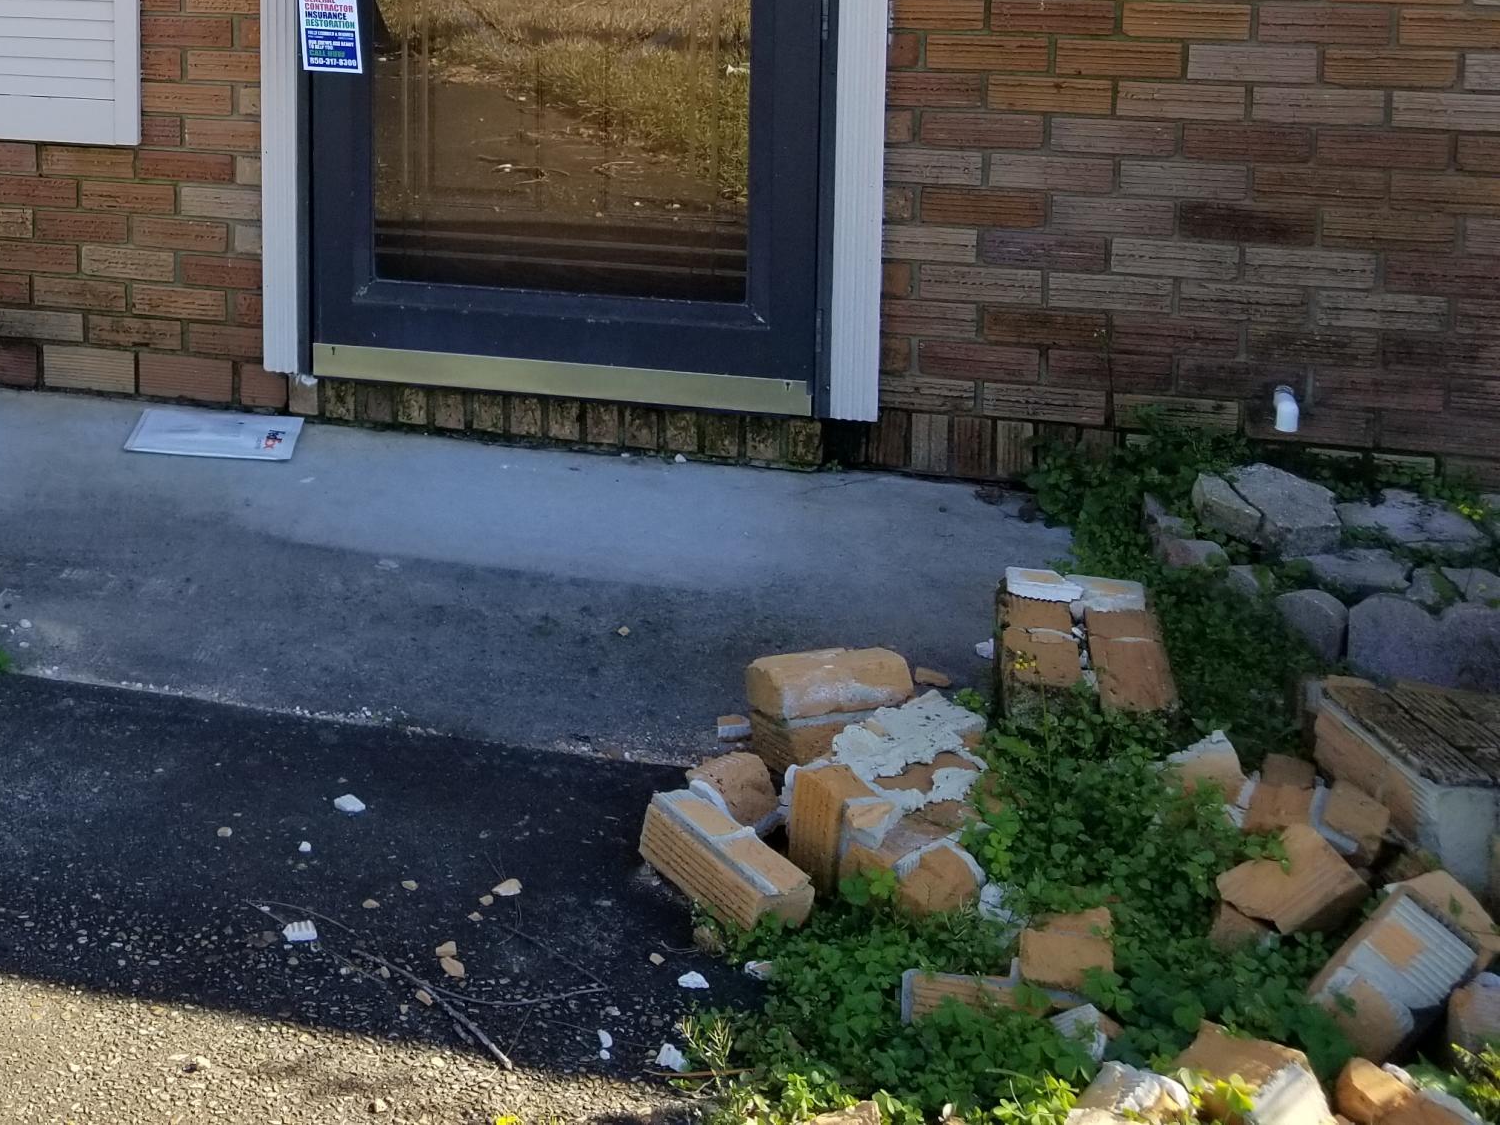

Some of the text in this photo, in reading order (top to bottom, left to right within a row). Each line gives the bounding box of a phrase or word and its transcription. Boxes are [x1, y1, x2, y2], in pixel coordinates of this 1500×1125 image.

[304, 2, 354, 13] CONTRACTOR
[305, 11, 347, 21] INSURANCE
[305, 18, 356, 29] RESTORATION
